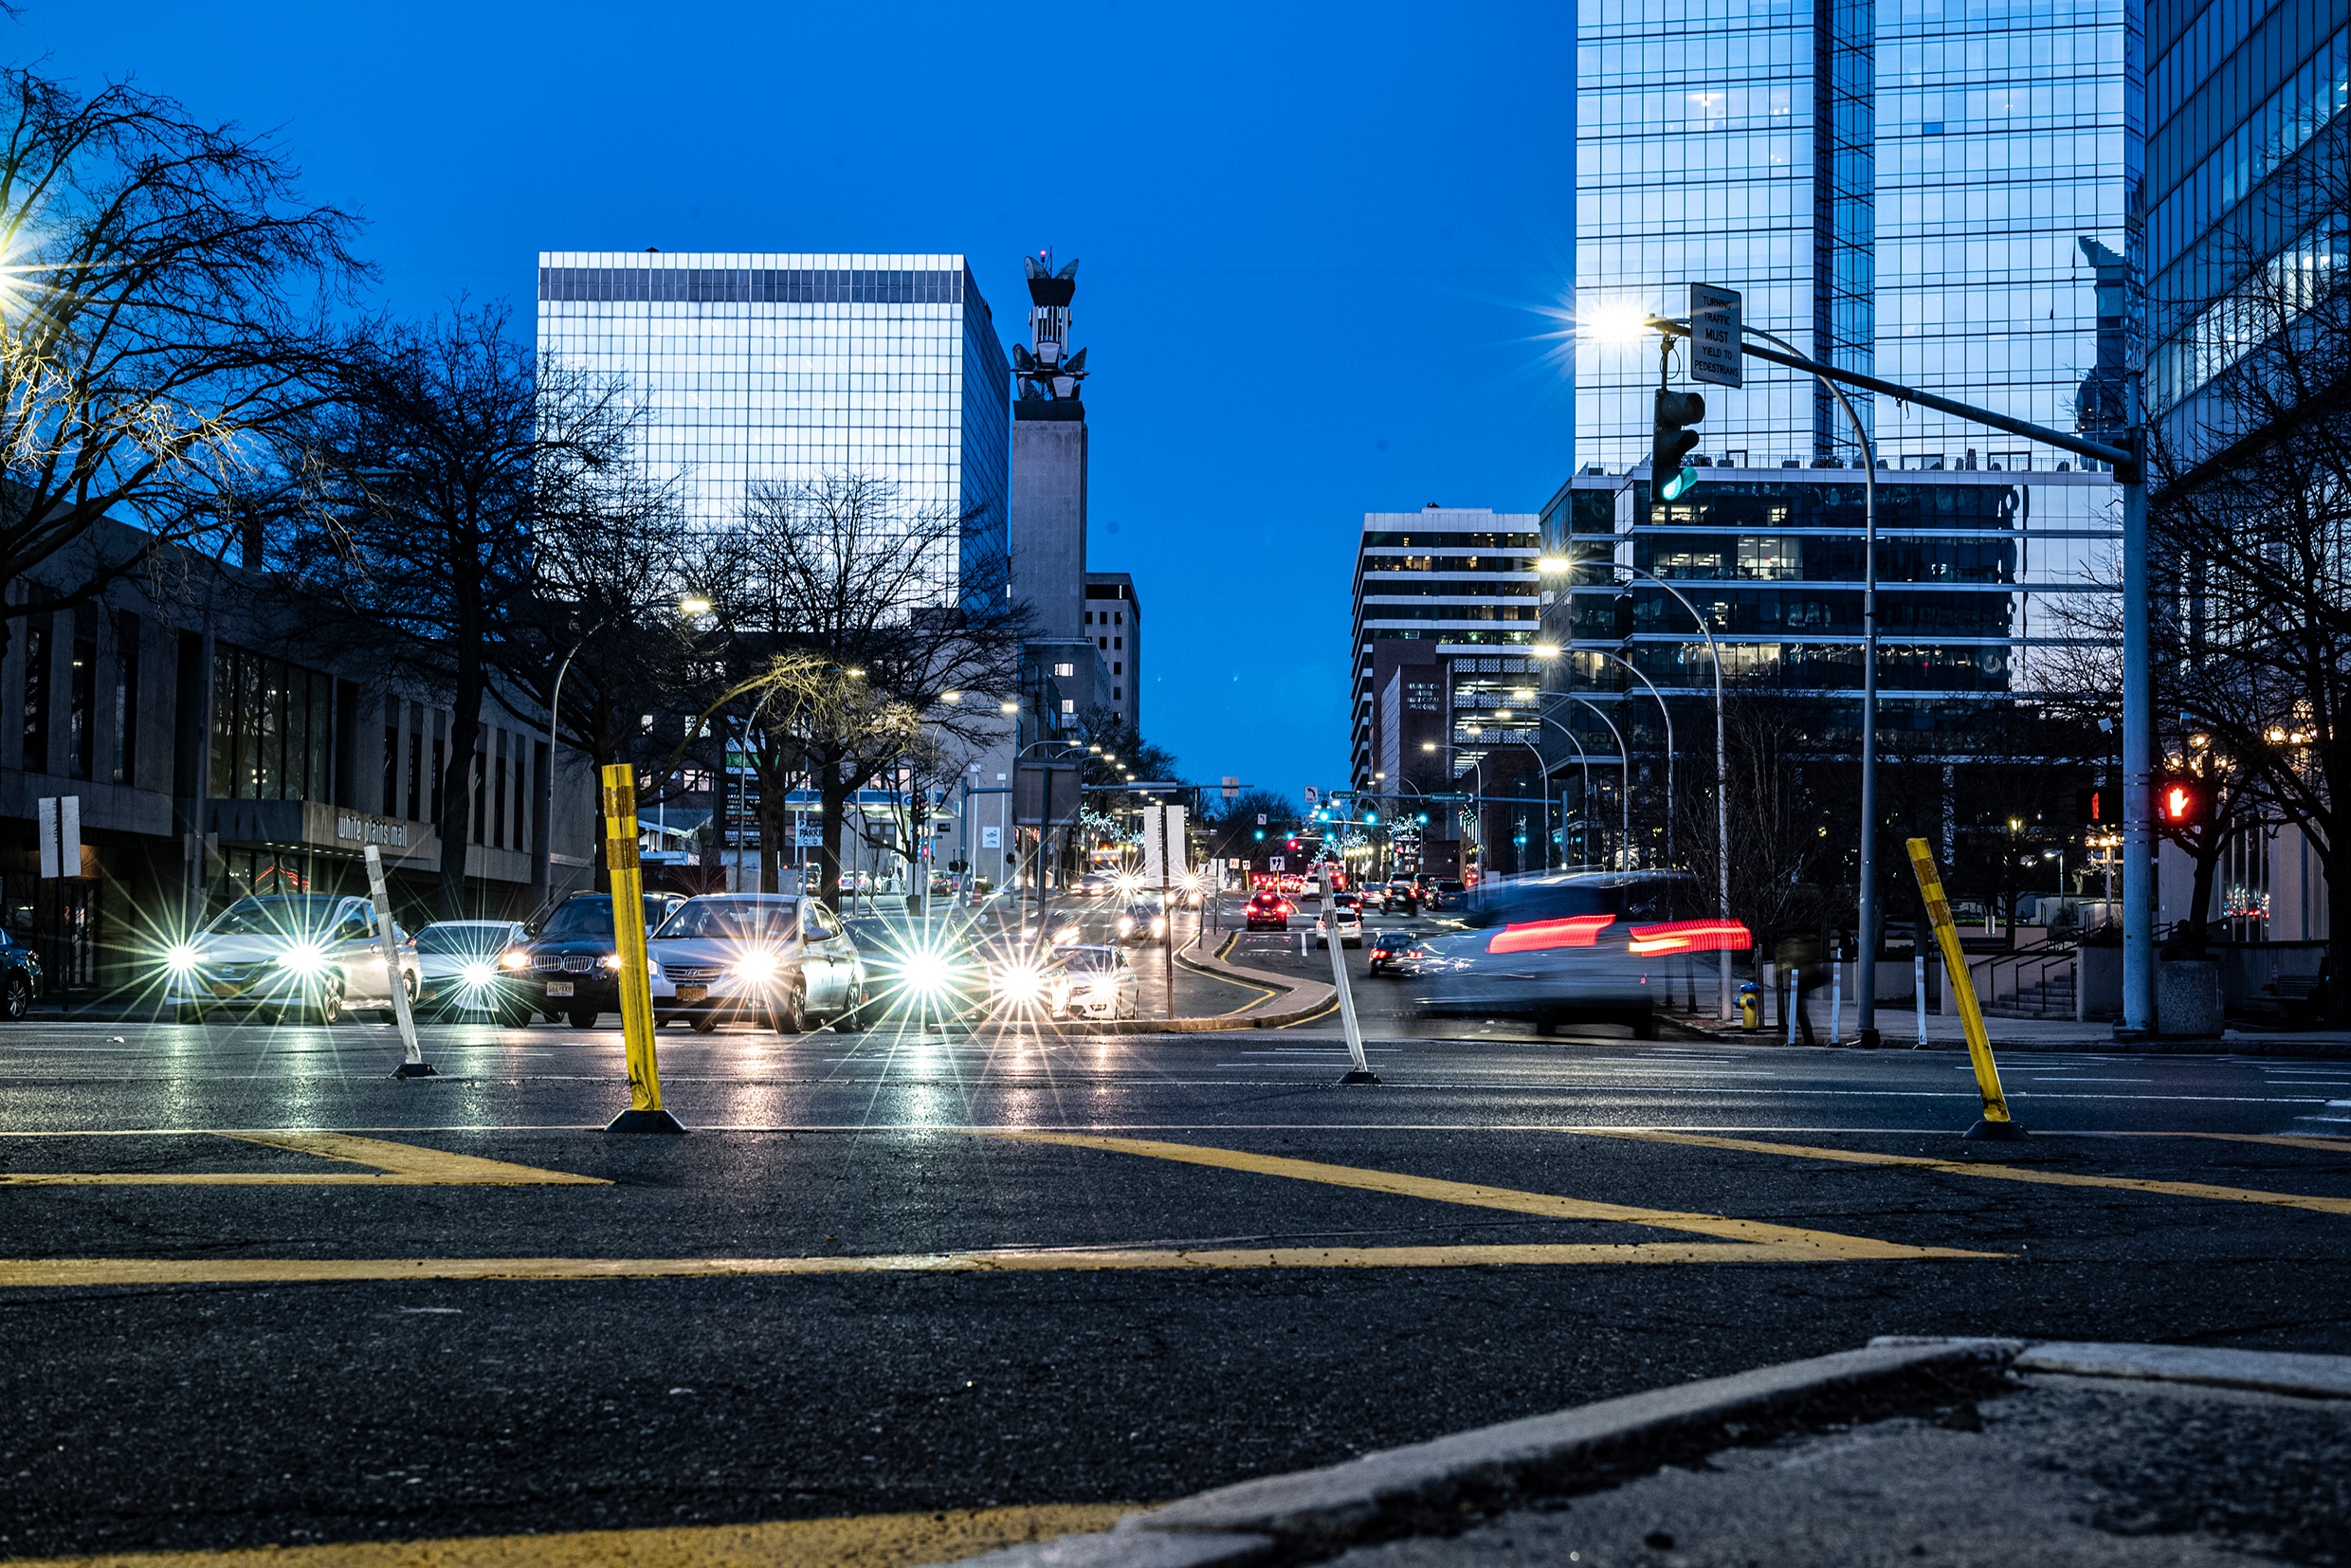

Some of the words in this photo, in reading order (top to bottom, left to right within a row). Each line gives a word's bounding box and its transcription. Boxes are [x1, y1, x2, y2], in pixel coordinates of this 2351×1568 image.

[1703, 296, 1731, 310] TURNING
[1704, 312, 1730, 326] TRAFFIC
[1705, 328, 1728, 343] MUST
[1702, 345, 1722, 358] YIELD
[1723, 350, 1732, 360] TO
[1694, 360, 1739, 377] PEDESTRIANS
[337, 815, 360, 841] white
[364, 819, 389, 845] plains
[391, 825, 408, 848] mall
